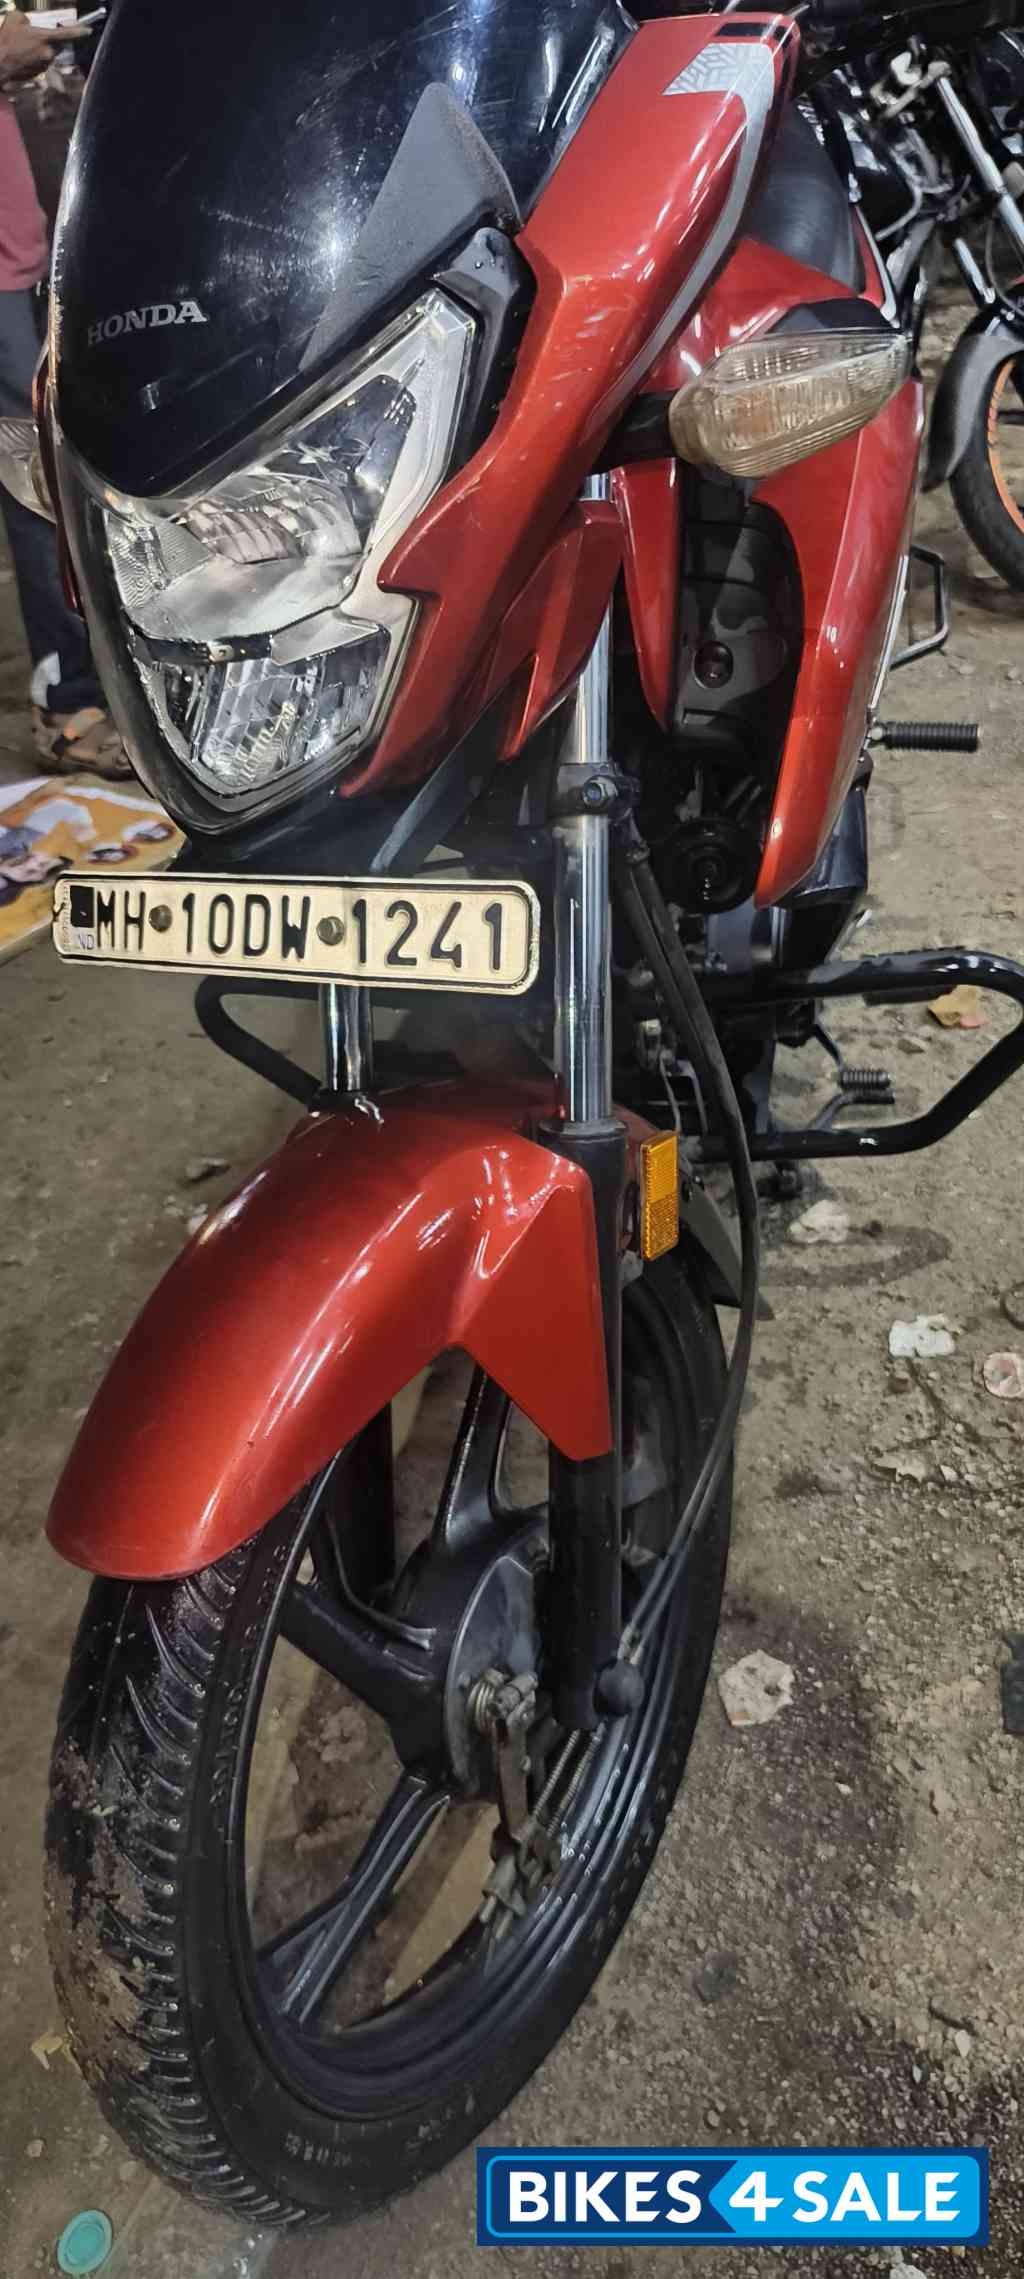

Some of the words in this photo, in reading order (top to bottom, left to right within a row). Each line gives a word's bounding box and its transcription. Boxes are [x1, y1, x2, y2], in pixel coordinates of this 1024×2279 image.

[87, 299, 208, 348] HONDA
[96, 889, 148, 953] MH
[181, 892, 312, 961] 10DW
[351, 898, 503, 972] 1241
